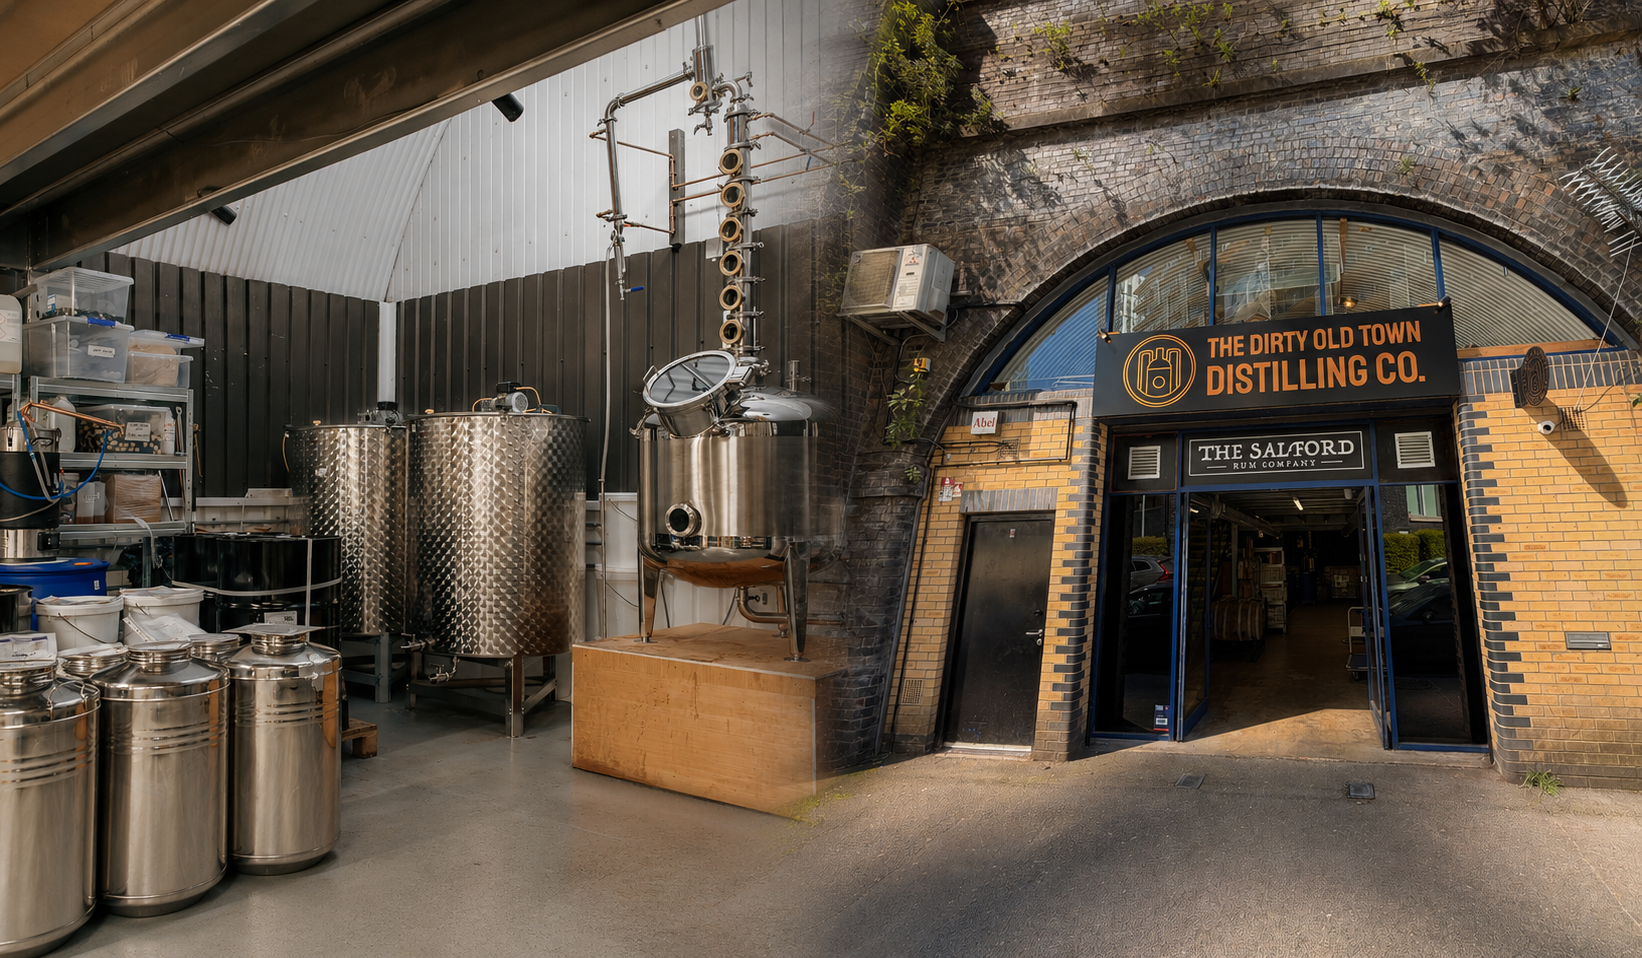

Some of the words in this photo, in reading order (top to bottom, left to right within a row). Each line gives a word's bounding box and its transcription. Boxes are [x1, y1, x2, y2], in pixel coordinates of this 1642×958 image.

[1207, 335, 1245, 358] THE
[1250, 330, 1308, 355] DIRTY
[1313, 326, 1354, 350] OLD
[1358, 320, 1421, 347] TOWN
[1207, 354, 1368, 396] DISTILLING
[1375, 351, 1426, 385] CO.
[973, 417, 996, 428] Abel
[1198, 444, 1243, 461] THE
[1250, 440, 1355, 459] SALFORD
[1233, 462, 1257, 470] RUM
[1262, 460, 1316, 469] COMPANY
